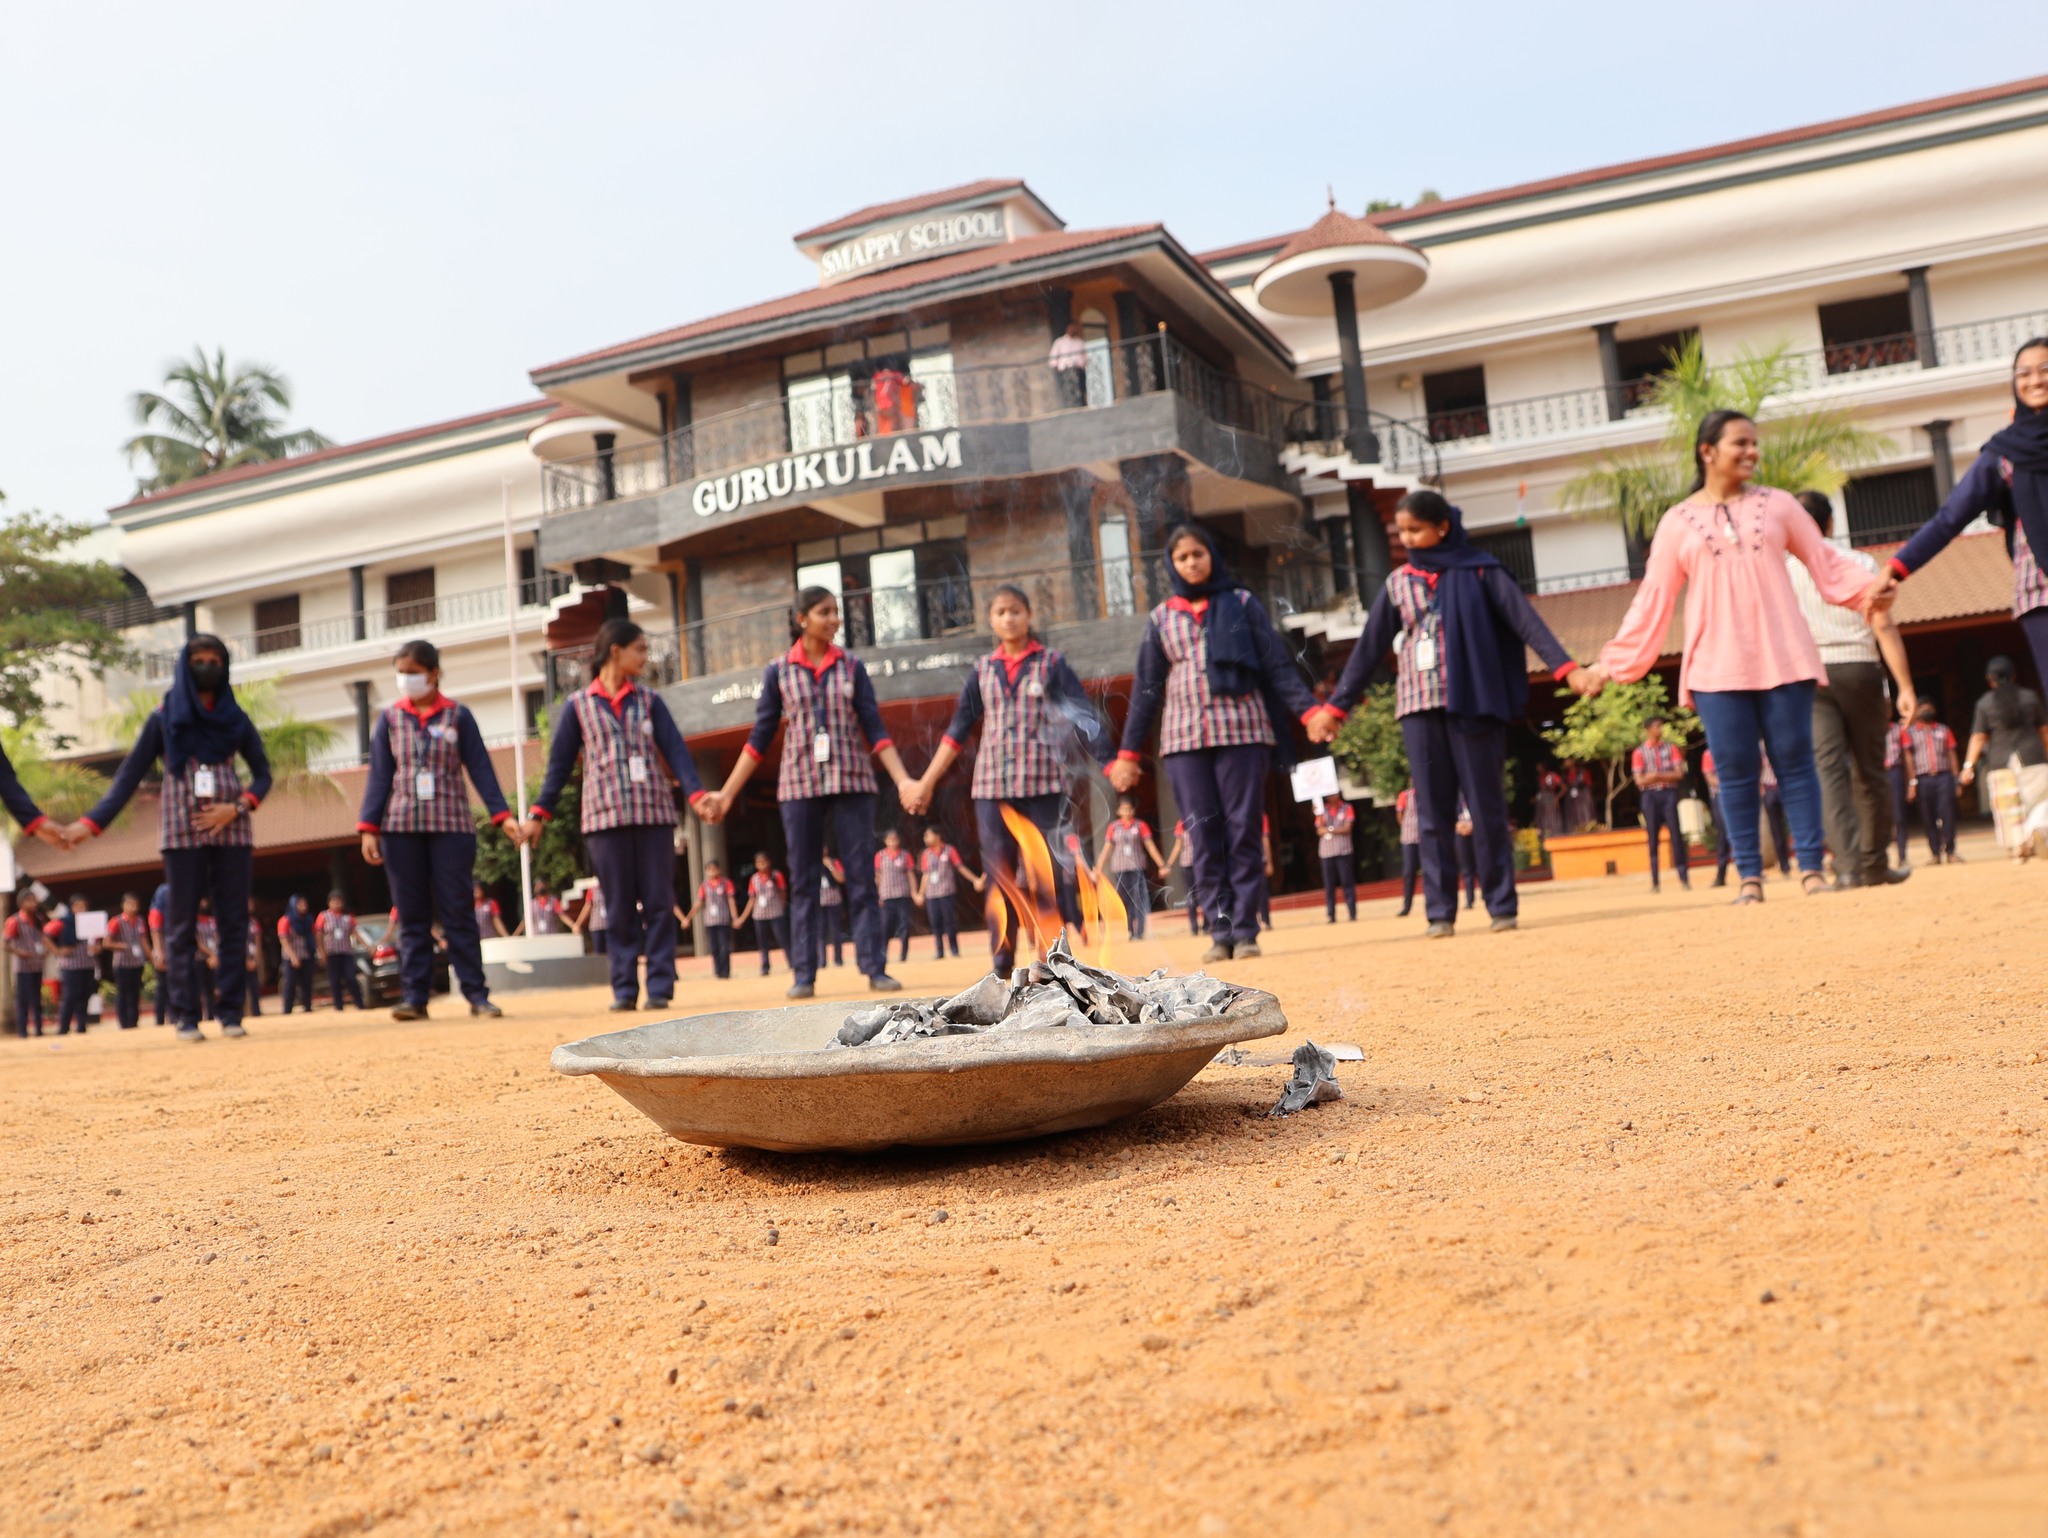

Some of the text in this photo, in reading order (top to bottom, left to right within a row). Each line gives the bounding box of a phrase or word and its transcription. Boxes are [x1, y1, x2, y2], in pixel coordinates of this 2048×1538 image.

[821, 212, 1001, 276] SMAPPY SCHOOL
[692, 431, 962, 516] GURUKULAM
